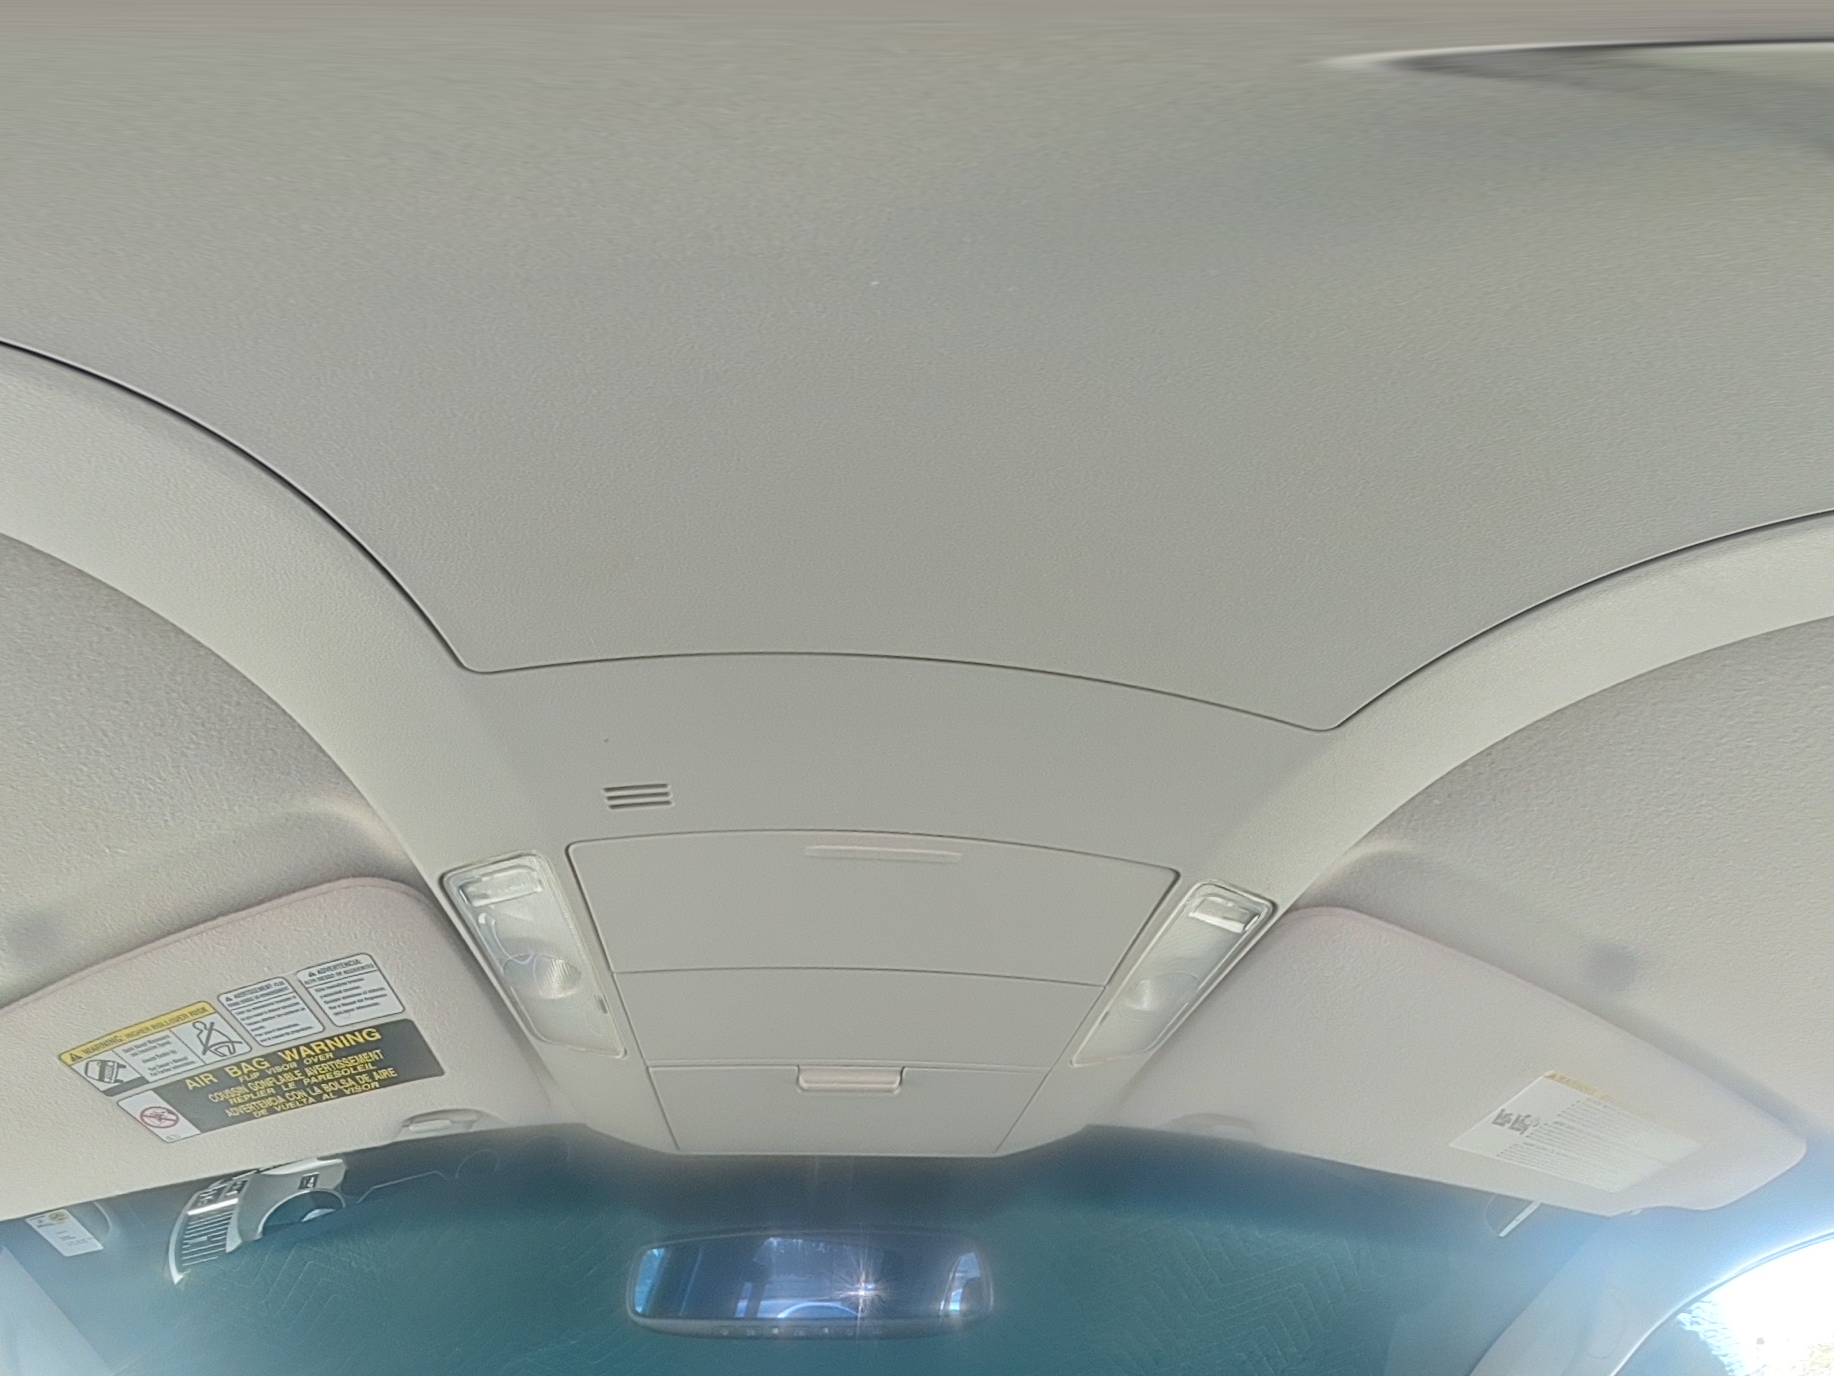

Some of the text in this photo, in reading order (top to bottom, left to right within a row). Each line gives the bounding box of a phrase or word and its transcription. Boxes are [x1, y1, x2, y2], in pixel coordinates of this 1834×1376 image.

[184, 1027, 382, 1091] AIR BAG WARNING
[208, 1049, 384, 1103] COUSSIN GONFLABLE AVERTISSEMENT
[239, 1051, 334, 1083] FLIP VISOR OVER
[225, 1067, 398, 1119] ADVERTENCIA CON LA BOLSA DE AIRE
[228, 1087, 275, 1105] REPLIER
[282, 1081, 296, 1092] LE
[274, 1097, 316, 1113] VUELTA
[322, 1090, 337, 1102] AL
[342, 1080, 380, 1097] VISOR
